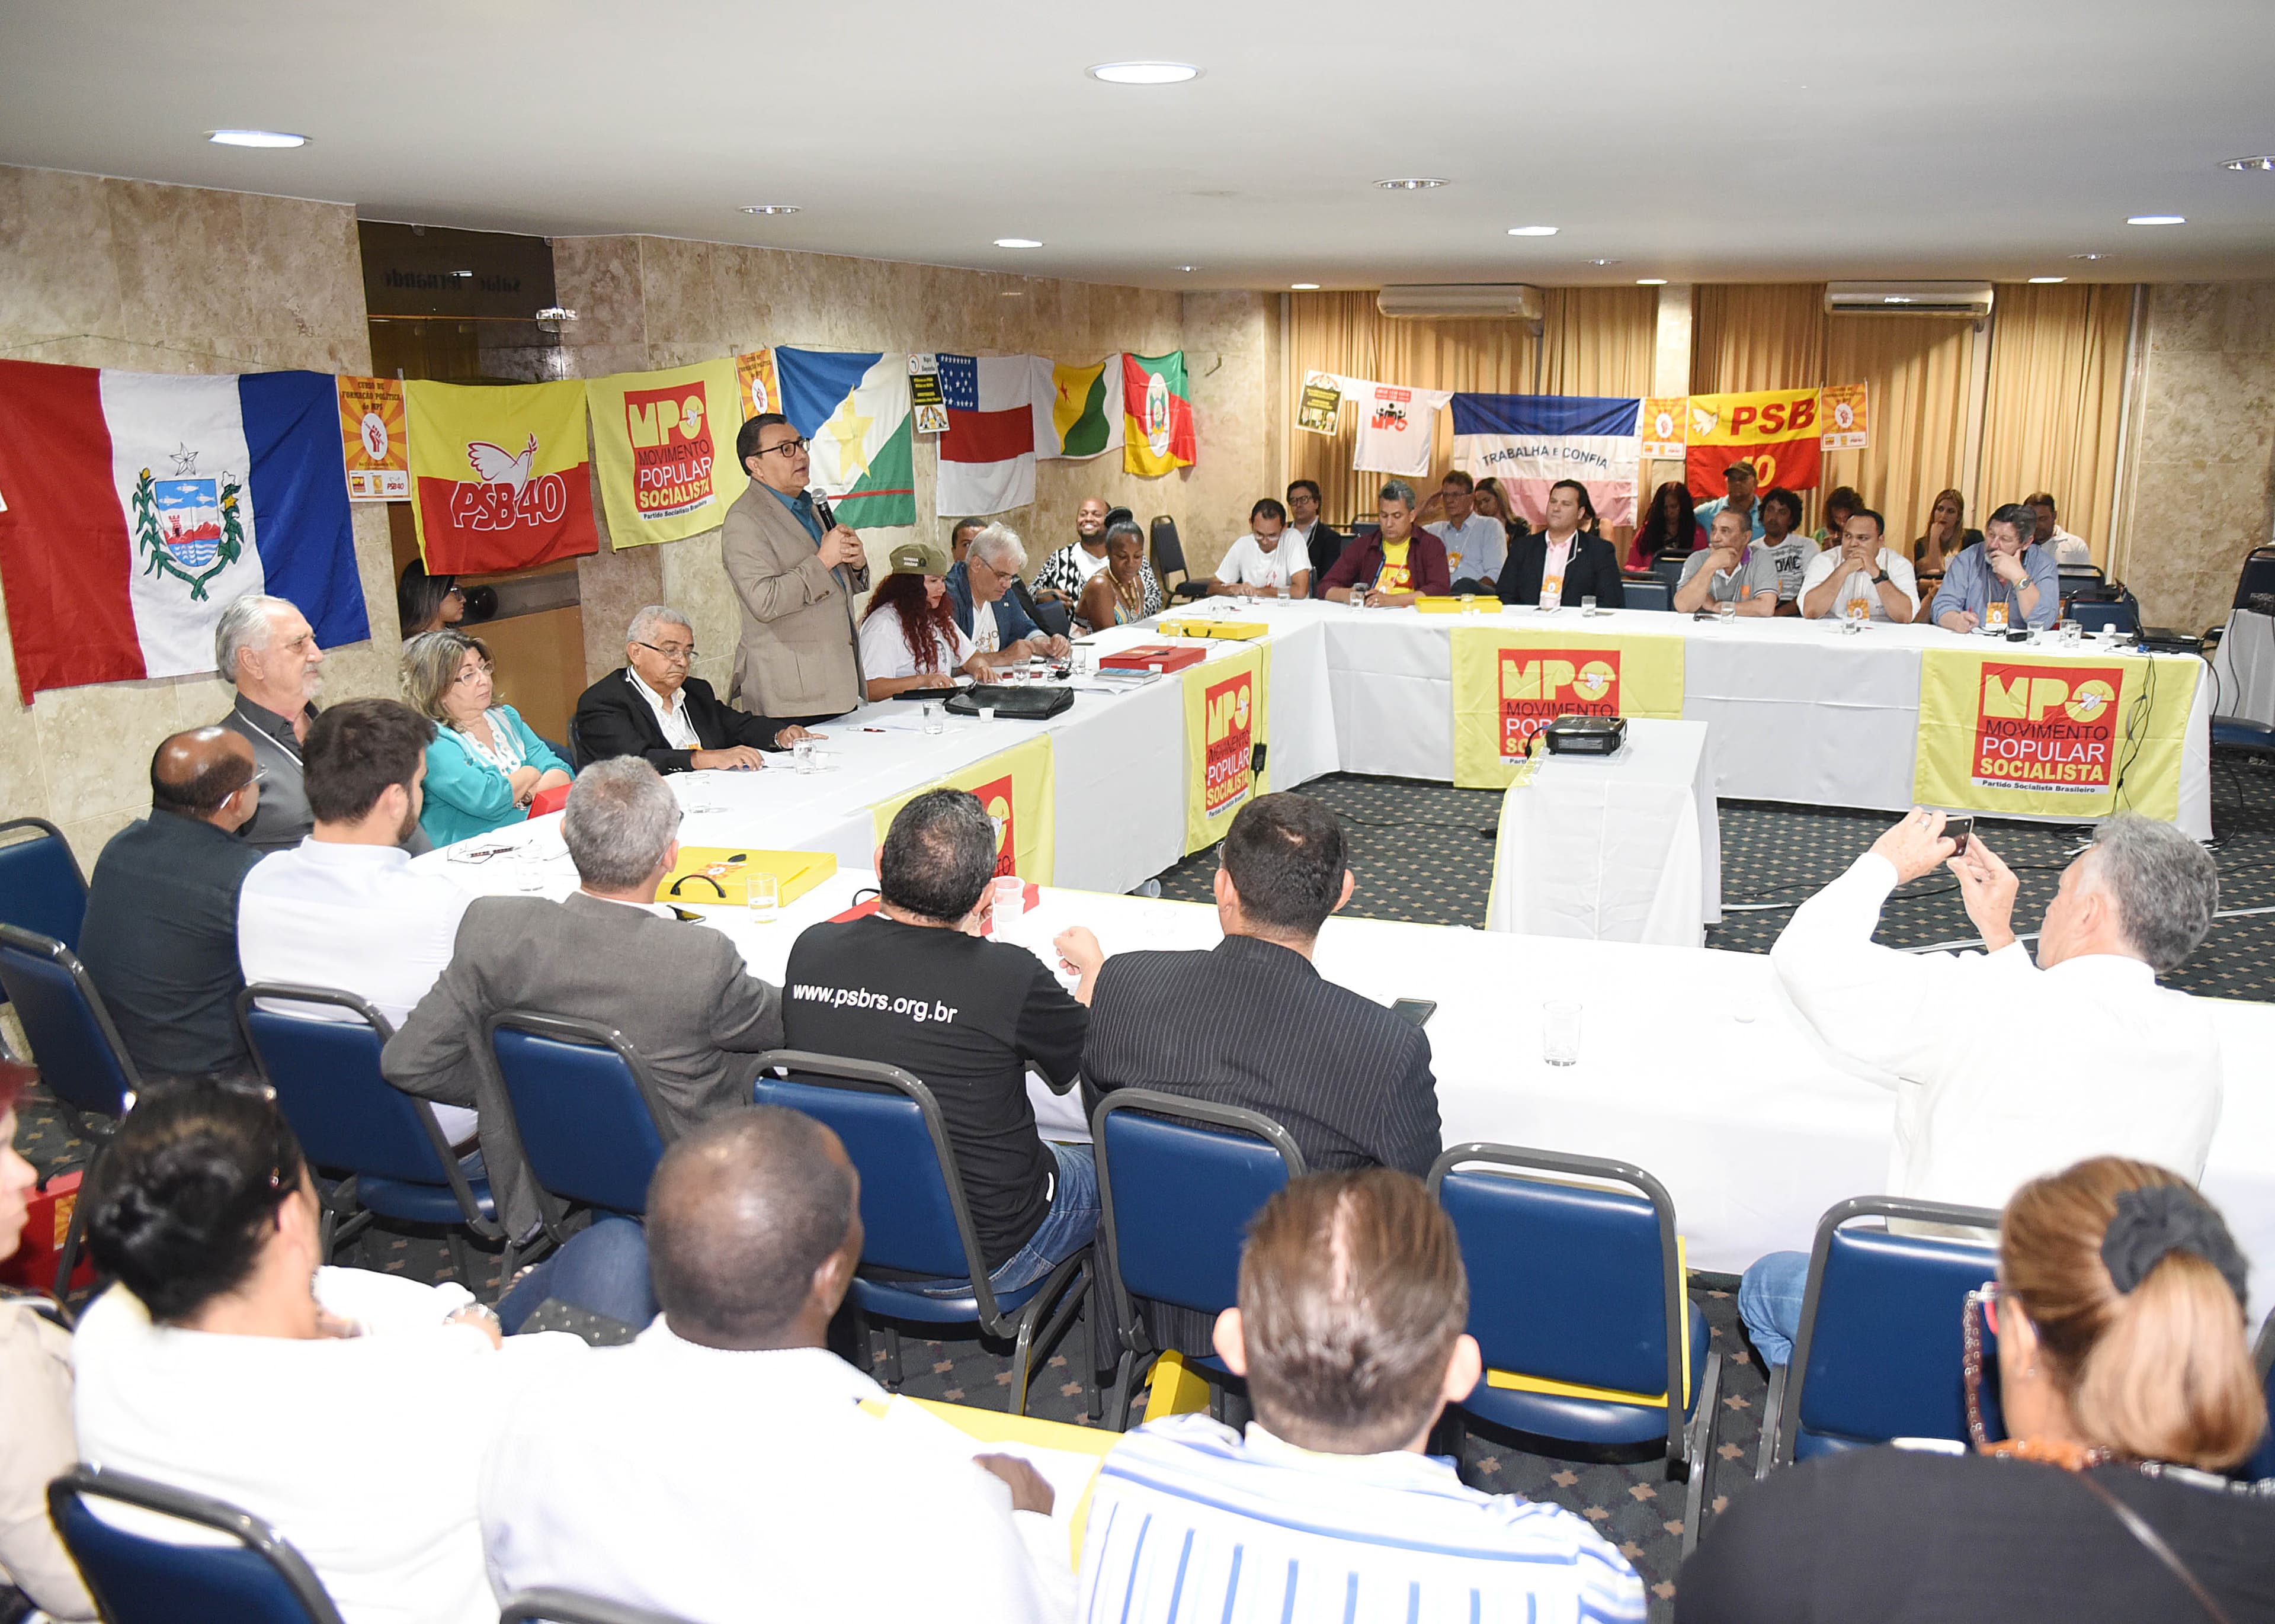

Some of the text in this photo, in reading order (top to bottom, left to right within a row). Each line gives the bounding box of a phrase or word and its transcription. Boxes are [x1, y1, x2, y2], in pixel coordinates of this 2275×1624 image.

[1731, 398, 1816, 436] PSB
[638, 439, 710, 466] MOVIMENTO
[1482, 445, 1608, 469] TRABALHA E CONFIA
[640, 456, 712, 489] POPULAR
[1742, 454, 1776, 488] 0
[640, 477, 710, 508] SOCIALISTA
[664, 508, 690, 517] Socialista
[1507, 702, 1613, 717] MOVIMENTO
[1986, 719, 2108, 740] MOVIMENTO
[1209, 730, 1250, 763] MOVIMENTO
[1982, 736, 2105, 762] POPULAR
[1207, 746, 1249, 787] POPULAR
[1980, 758, 2104, 781] SOCIALISTA
[1207, 768, 1249, 806] SOCIALISTA
[1982, 779, 2095, 794] Partido Socialista Brasileiro
[793, 984, 957, 1023] www.psbrs.org.br
